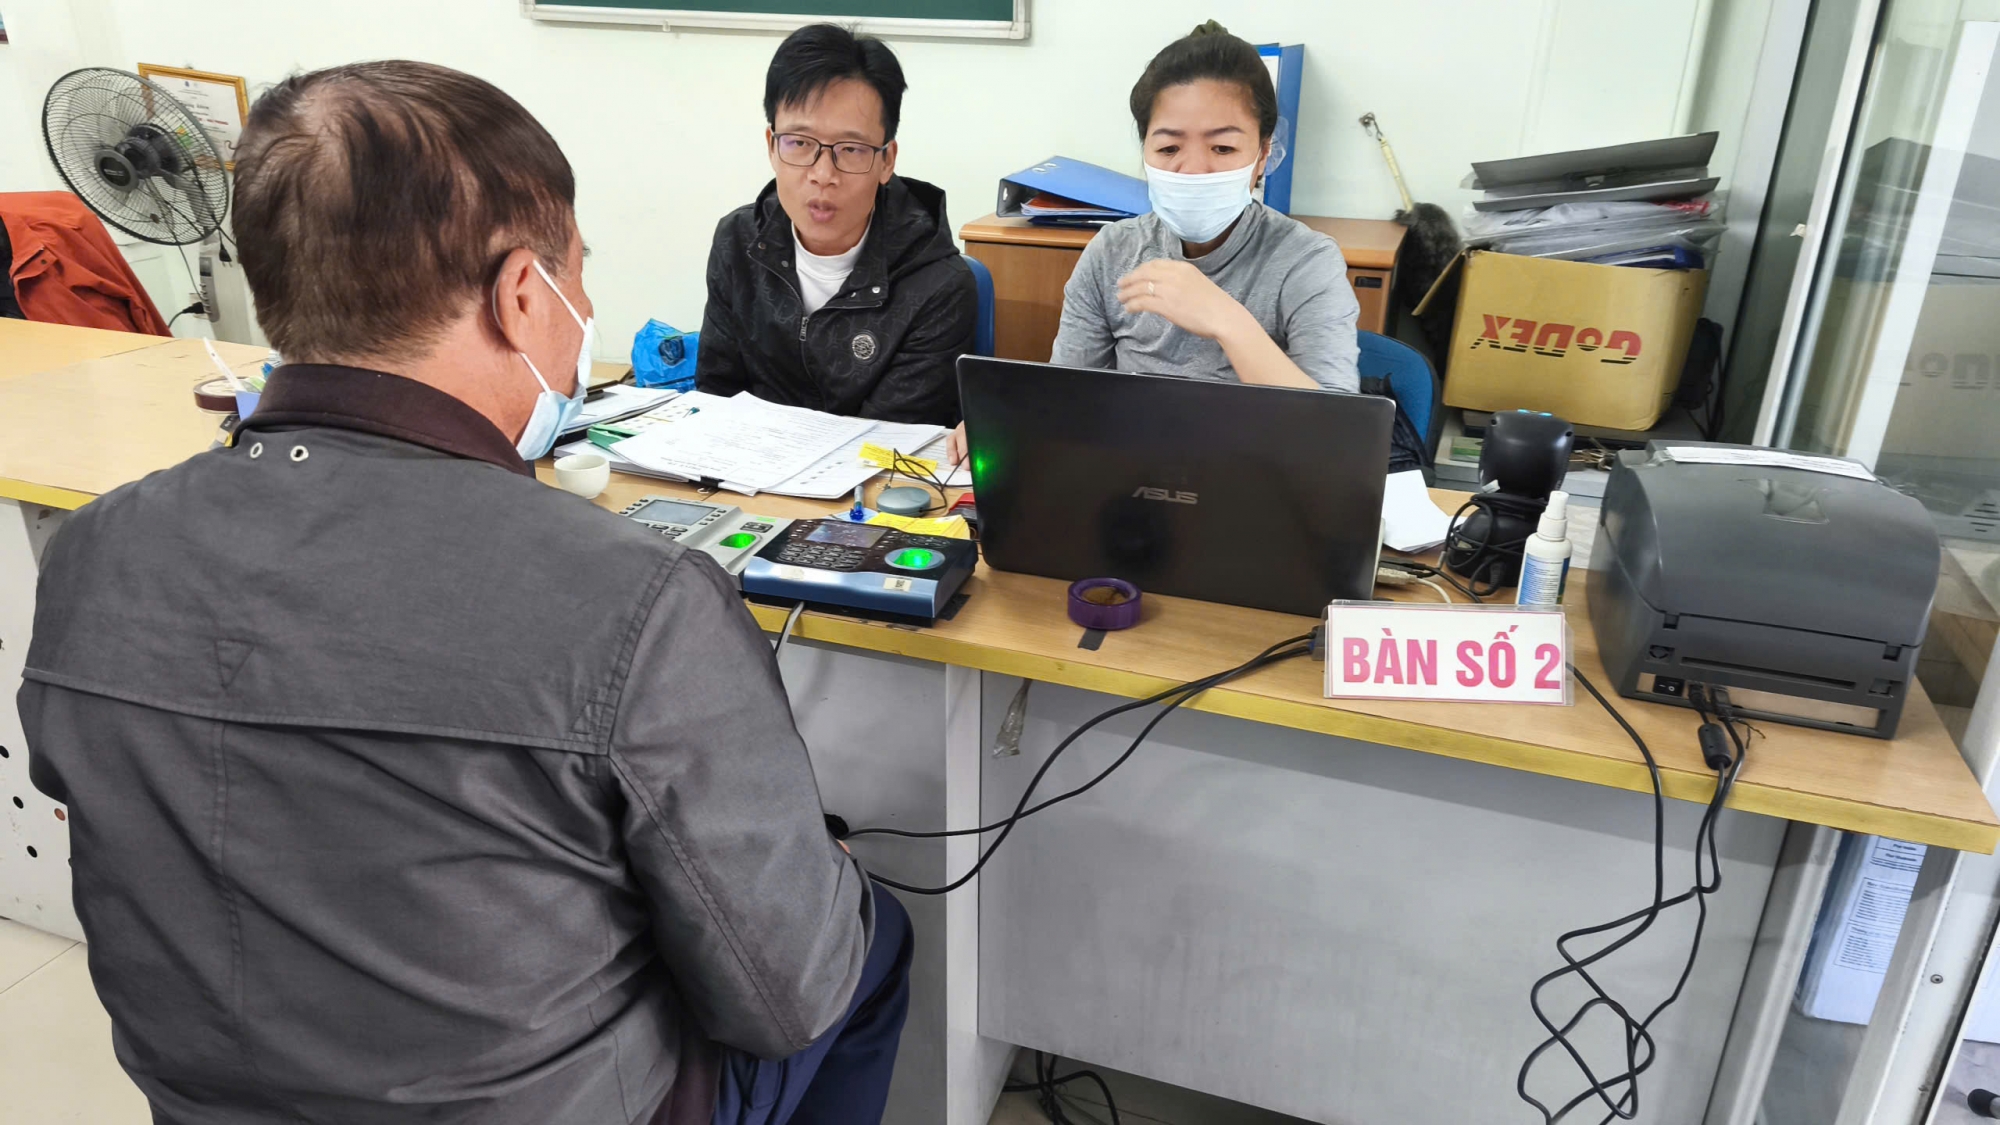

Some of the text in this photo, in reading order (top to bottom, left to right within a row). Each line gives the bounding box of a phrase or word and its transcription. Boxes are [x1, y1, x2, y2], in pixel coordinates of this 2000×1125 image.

[1131, 486, 1199, 505] ASUS
[1343, 624, 1561, 690] BÀN SỐ 2
